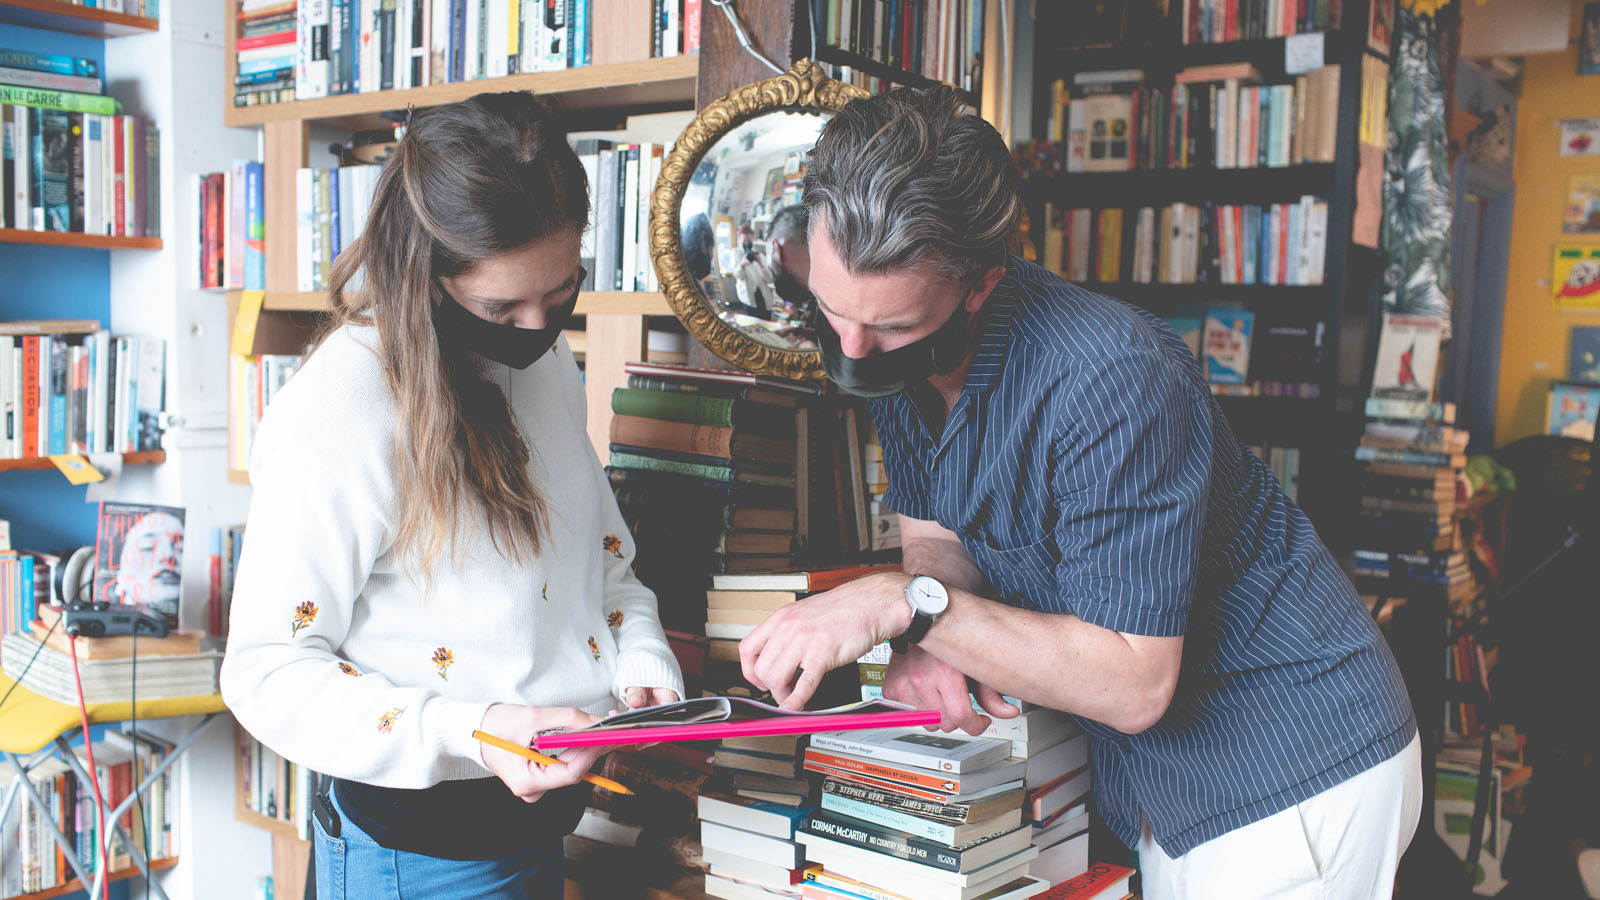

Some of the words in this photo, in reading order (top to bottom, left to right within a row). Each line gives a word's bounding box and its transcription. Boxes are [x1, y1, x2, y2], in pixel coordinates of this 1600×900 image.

[27, 338, 36, 416] RECURSION
[866, 671, 882, 680] NEIL
[815, 738, 826, 746] Ways
[858, 746, 873, 755] Berger
[834, 759, 846, 767] PAUL
[846, 762, 864, 770] DOLAN
[865, 766, 892, 776] HAPPINESS
[899, 773, 919, 782] DESIGN
[838, 785, 866, 799] STEPHEN
[867, 791, 885, 802] HERO
[900, 799, 922, 812] JAMES
[923, 803, 944, 814] JOYCE
[811, 819, 836, 834] CORMAC
[836, 826, 868, 844] McCARTHY
[869, 836, 876, 844] NO
[876, 837, 897, 852] COUNTRY
[897, 844, 907, 854] FOR
[906, 846, 916, 856] OLD
[916, 848, 928, 859] MEN
[937, 854, 957, 866] PICADOR
